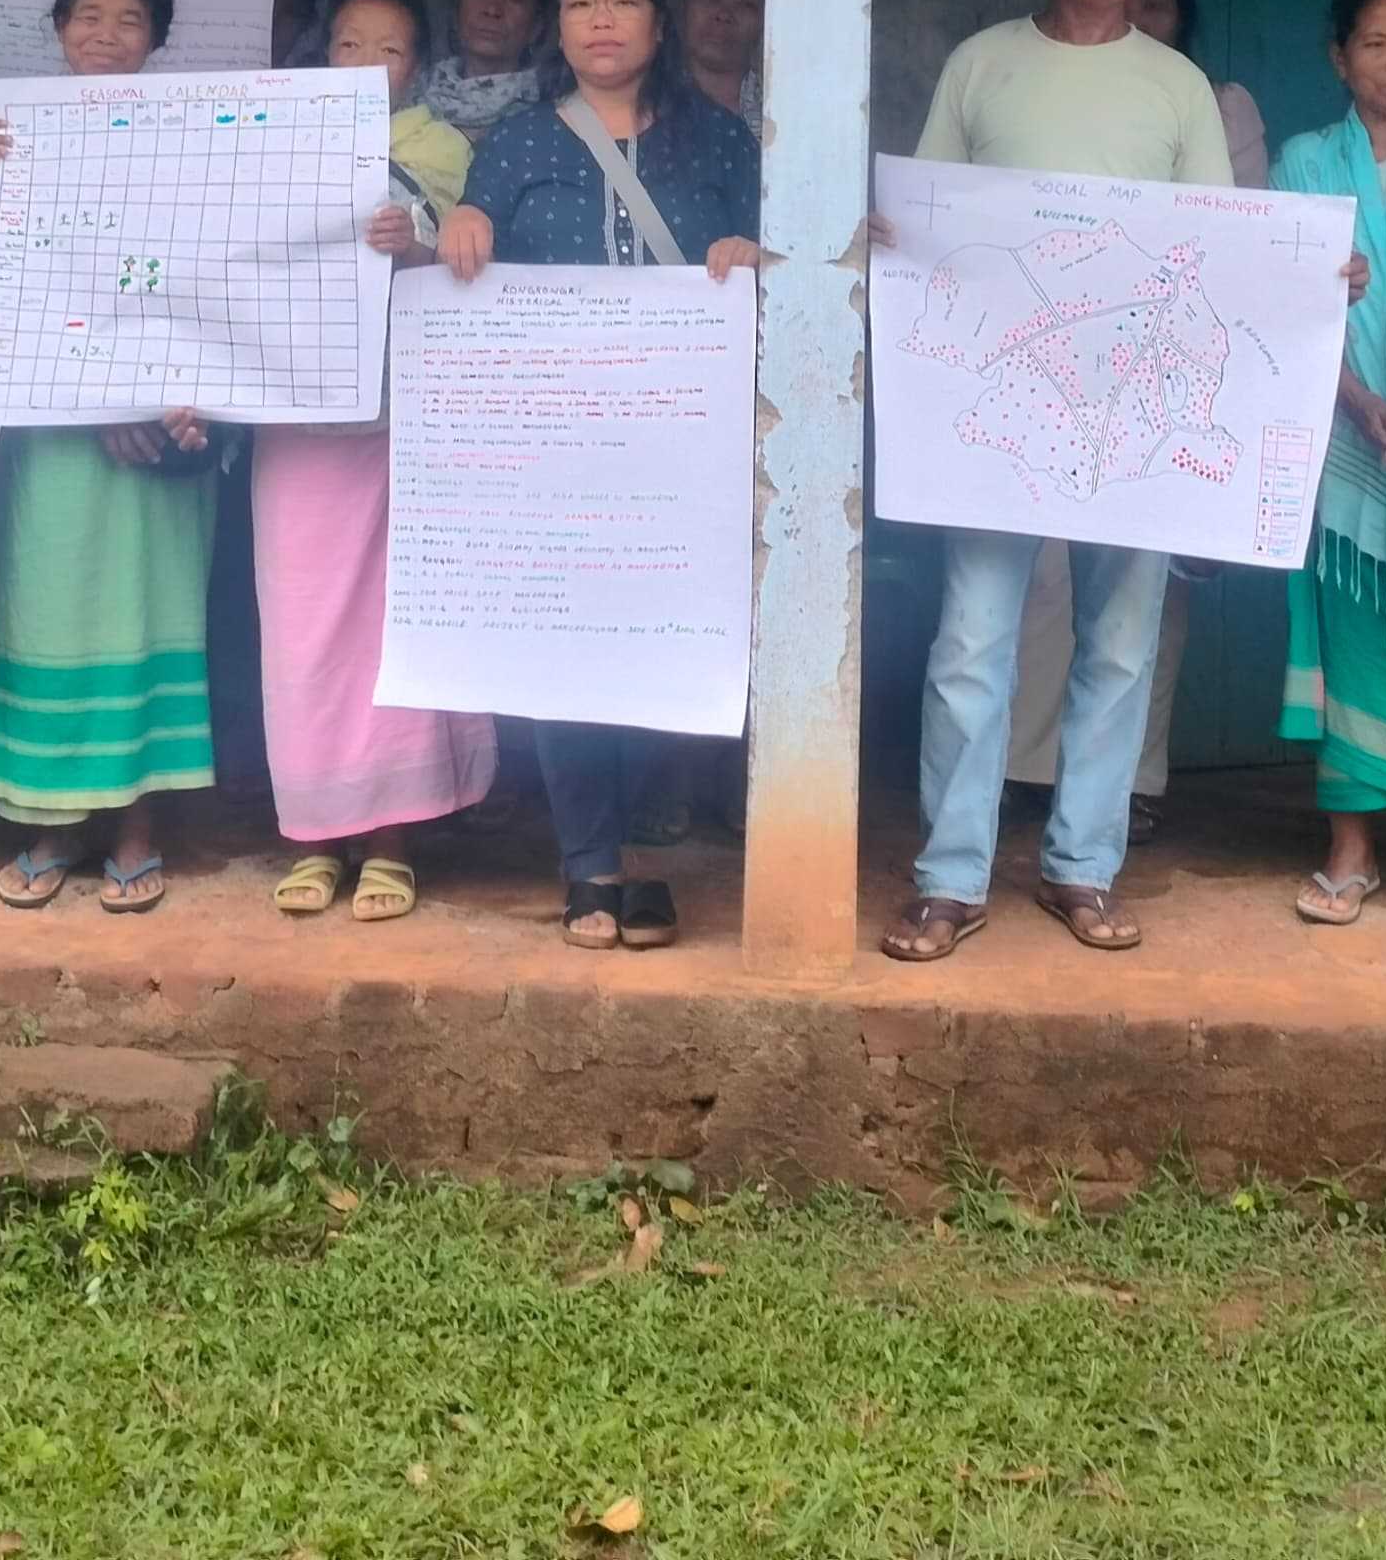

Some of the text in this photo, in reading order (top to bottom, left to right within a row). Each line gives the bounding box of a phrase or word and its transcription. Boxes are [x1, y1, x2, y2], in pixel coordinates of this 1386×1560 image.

[81, 86, 148, 101] SEASONAL
[1031, 179, 1088, 198] SOCIAL
[1107, 184, 1143, 204] MAP
